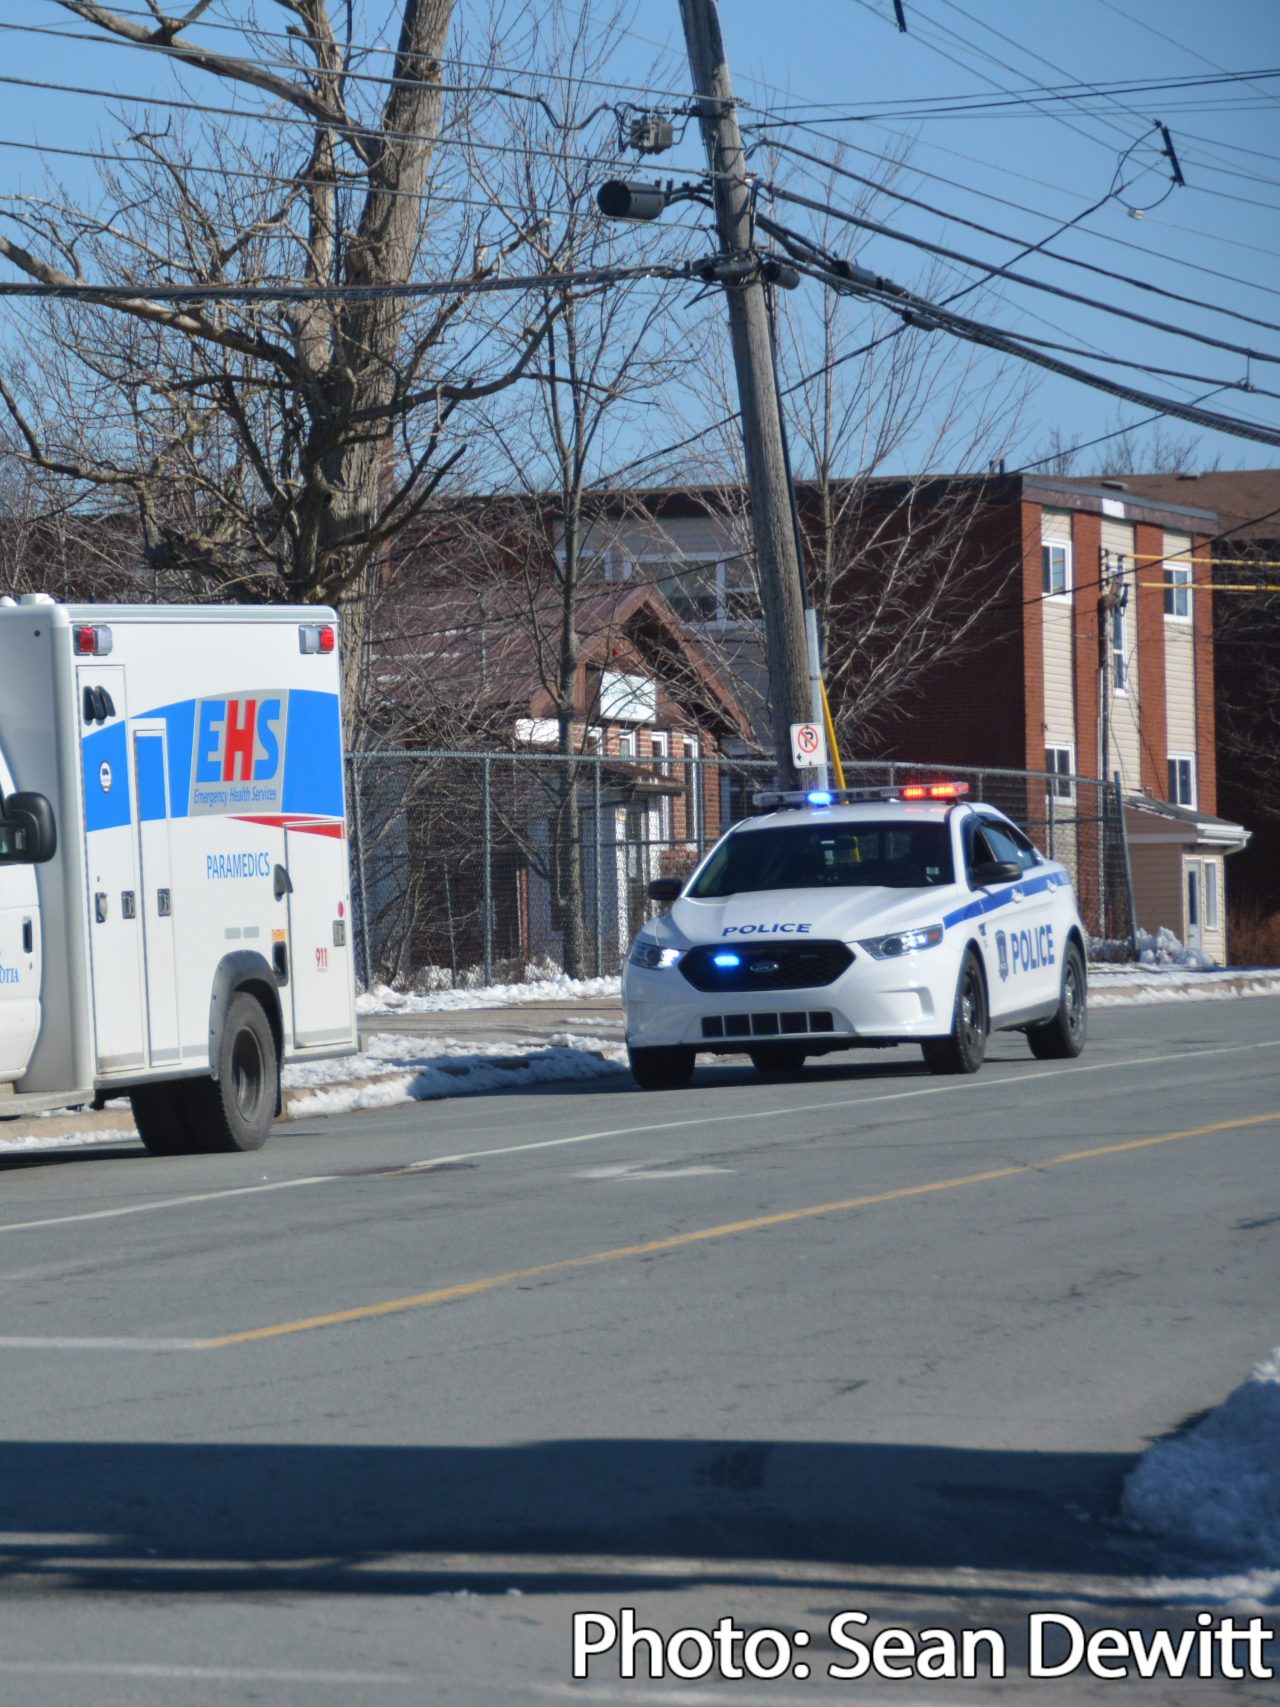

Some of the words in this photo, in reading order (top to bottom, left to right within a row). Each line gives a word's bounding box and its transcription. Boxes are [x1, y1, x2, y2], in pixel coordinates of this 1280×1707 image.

[196, 699, 281, 783] EHS
[193, 788, 228, 807] Emergency
[230, 786, 251, 802] Health
[252, 784, 277, 801] Services
[206, 852, 271, 879] PARAMEDICS
[722, 923, 812, 937] POLICE
[315, 947, 328, 967] 911
[1011, 924, 1055, 975] POLICE
